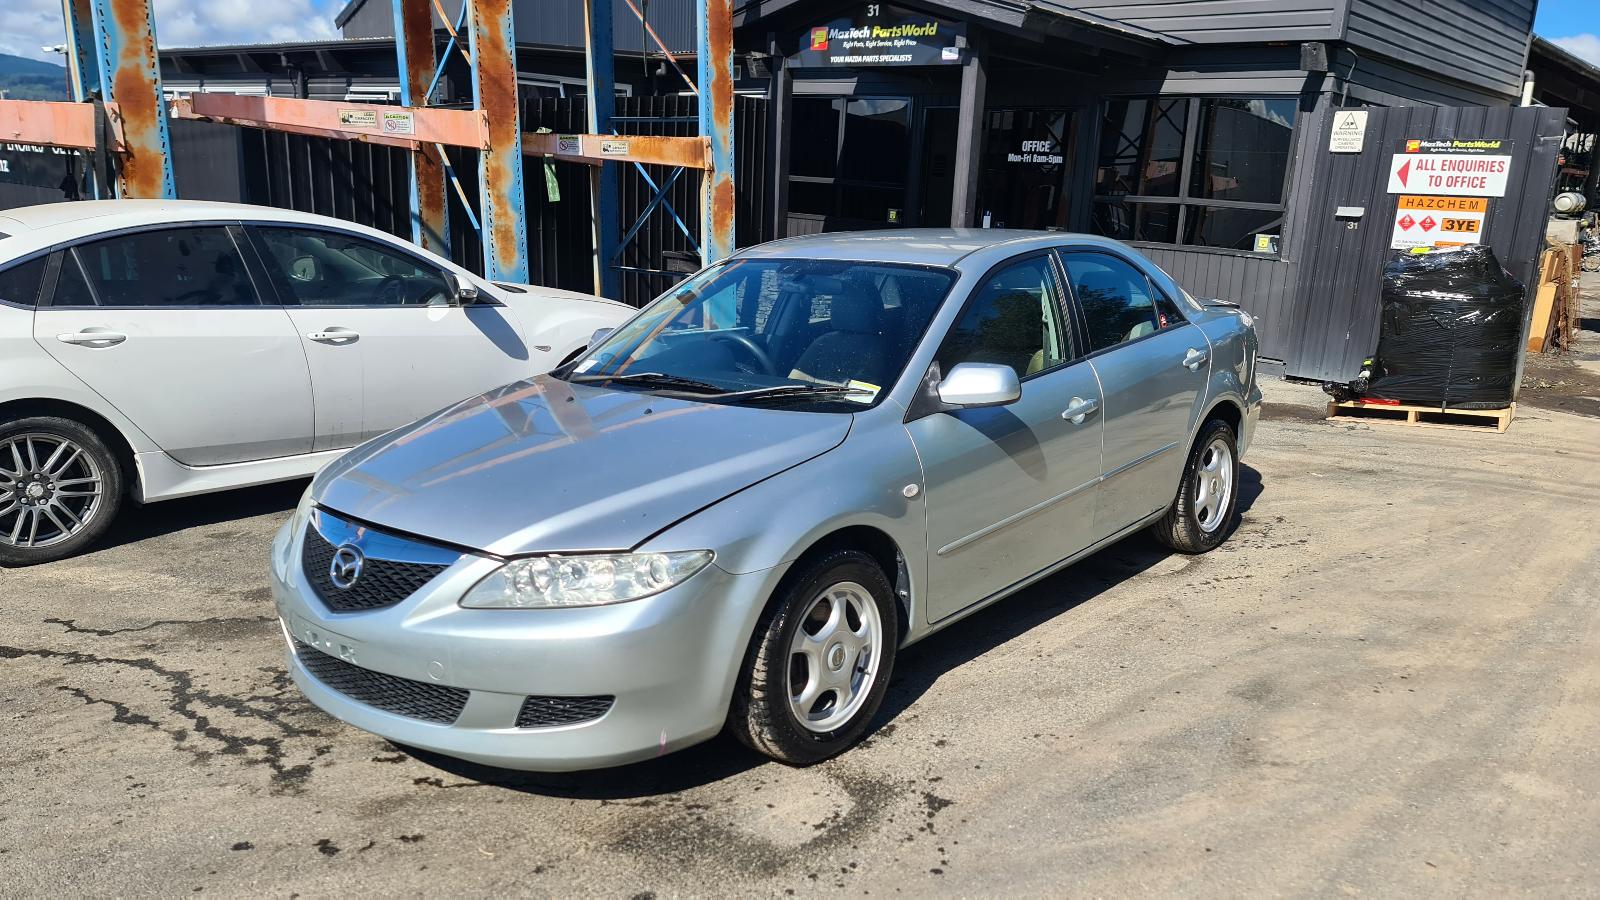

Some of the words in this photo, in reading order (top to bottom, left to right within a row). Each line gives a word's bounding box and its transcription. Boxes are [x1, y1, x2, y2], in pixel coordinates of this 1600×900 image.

[867, 4, 880, 17] 31
[829, 26, 871, 39] MazTech
[872, 22, 938, 38] PartsWorld
[845, 55, 861, 63] MAZDA
[879, 54, 912, 62] SPECIALISTS
[1021, 140, 1051, 152] OFFICE
[1420, 140, 1452, 148] MazTech
[1452, 140, 1501, 148] PartsWorld
[1007, 153, 1032, 162] Mon-Fri
[1032, 154, 1063, 164] 8am-5pm
[1416, 159, 1436, 171] ALL
[1440, 159, 1505, 173] ENQUIRIES
[1428, 175, 1442, 187] TO
[1446, 175, 1487, 189] OFFICE
[1406, 198, 1479, 210] HAZCHEM
[1347, 221, 1358, 230] 31
[1445, 219, 1476, 231] 3YE
